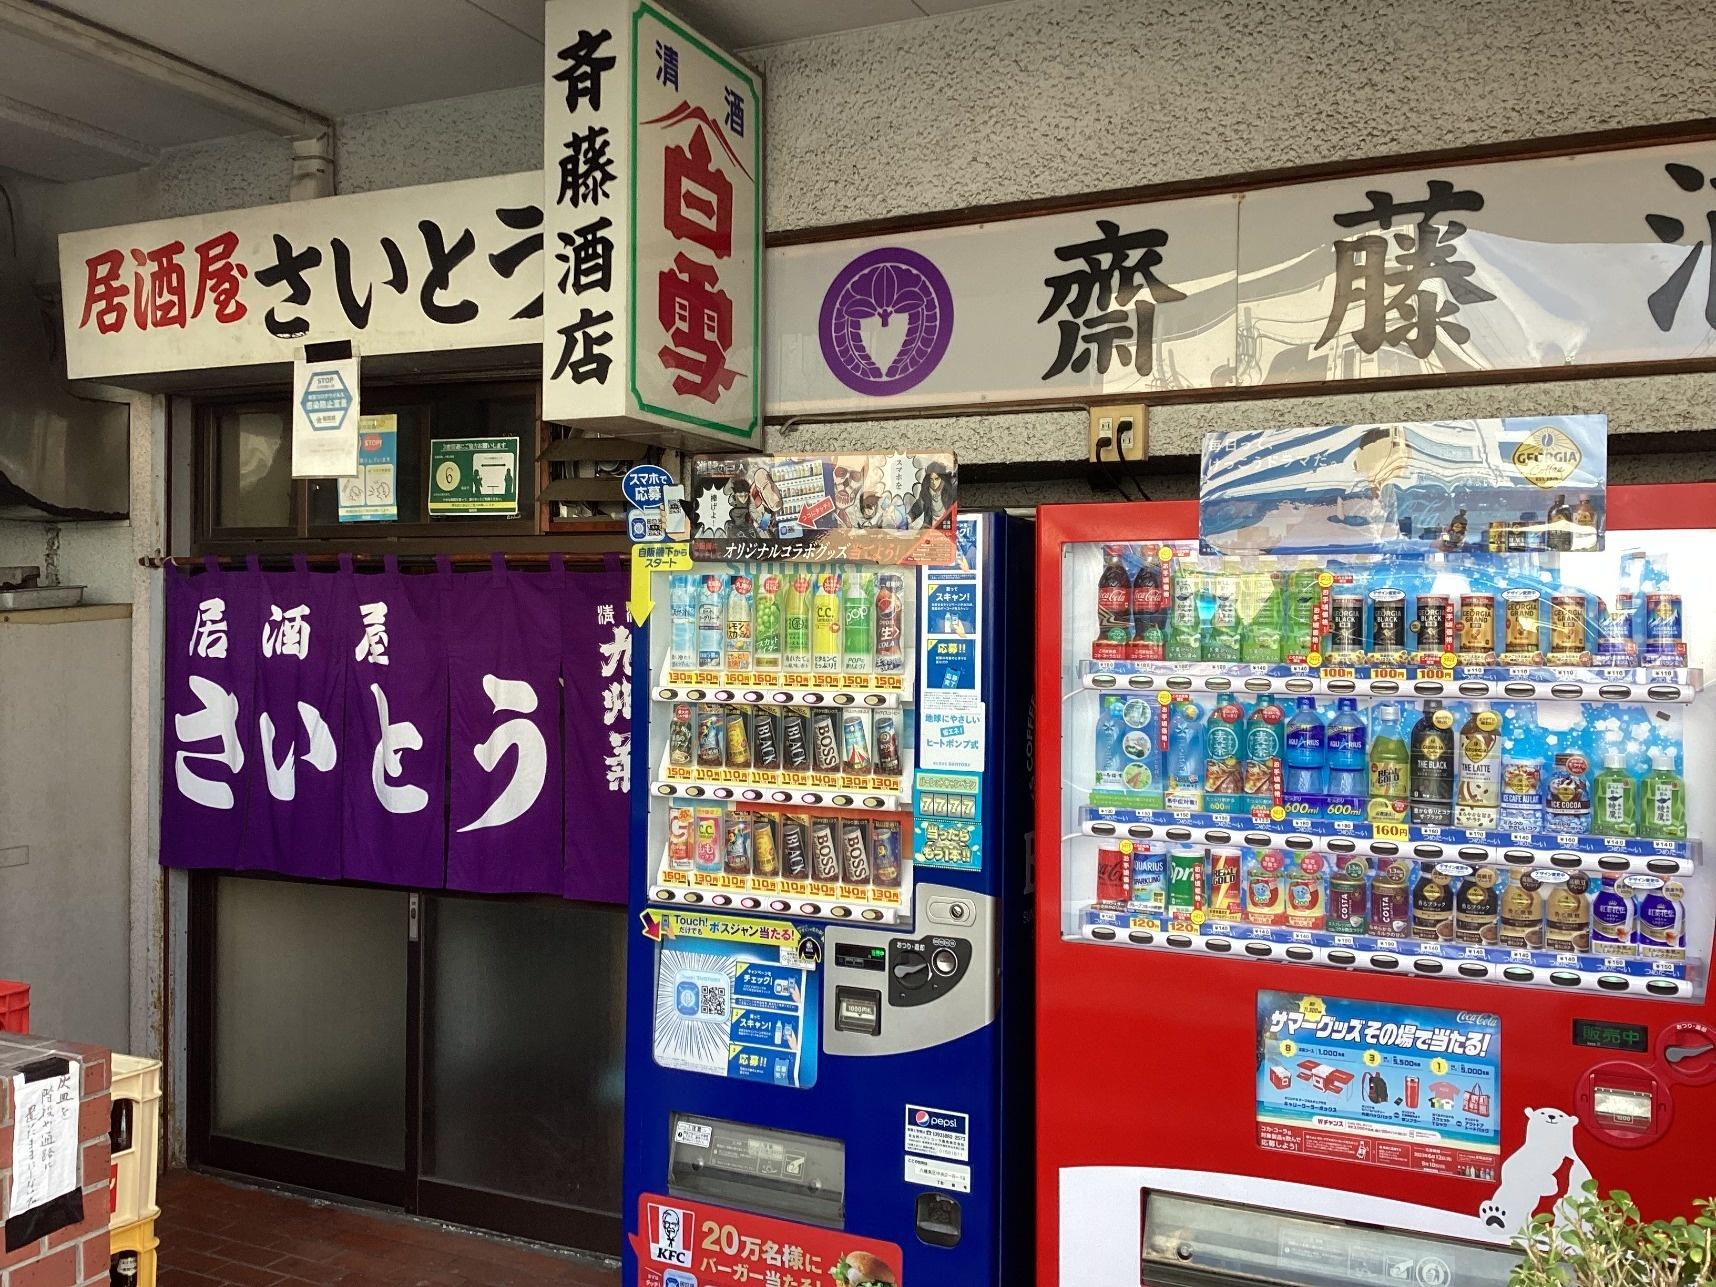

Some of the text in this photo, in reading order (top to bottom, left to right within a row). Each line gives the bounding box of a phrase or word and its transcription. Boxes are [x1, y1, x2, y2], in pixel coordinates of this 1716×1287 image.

[654, 39, 745, 139] 清酒
[551, 29, 618, 386] 斉藤酒店
[657, 124, 748, 405] 白雪
[1517, 451, 1577, 464] GEORGIA
[446, 467, 453, 483] 6
[630, 473, 667, 485] スマホで
[635, 487, 661, 501] 応募
[638, 547, 687, 557] 自販機下から
[645, 558, 677, 568] スタート
[189, 598, 389, 666] 居酒屋
[1322, 668, 1353, 677] 100円
[1373, 669, 1405, 678] 100円
[1420, 670, 1452, 678] 100円
[925, 713, 980, 724] 地球にやさしい
[757, 720, 777, 766] BLACK
[787, 722, 807, 767] BLACK
[818, 723, 837, 767] BOSS
[926, 738, 979, 750] ヒートポンプ式
[1213, 730, 1226, 756] 麦茶
[1254, 731, 1267, 757] 麦茶
[175, 675, 548, 833] さいとう
[1418, 760, 1448, 770] THE BLACK
[1473, 764, 1491, 773] LATTE
[1285, 803, 1319, 814] 600ml
[1327, 804, 1362, 816] 600ml
[1562, 801, 1582, 809] COCOA
[1374, 825, 1408, 837] 160円
[786, 832, 806, 875] BLACK
[816, 832, 836, 876] BOSS
[848, 835, 867, 878] BOSS
[1382, 897, 1390, 923] COSTA
[674, 915, 708, 927] Touch!
[1132, 919, 1160, 929] 120円
[679, 927, 703, 935] だけでも
[709, 921, 795, 941] ボスジャン当たる!
[1169, 923, 1199, 933] 120円
[739, 1018, 772, 1031] スキャン!
[1269, 1009, 1492, 1057] サマーグッズその場で当たる!
[1583, 1026, 1640, 1045] 販売中
[1369, 1054, 1375, 1062] 3
[931, 1117, 957, 1127] pepsi
[1260, 1140, 1298, 1151] 応募しよう!
[701, 1220, 822, 1274] 20万名様に
[657, 1247, 686, 1263] KFC
